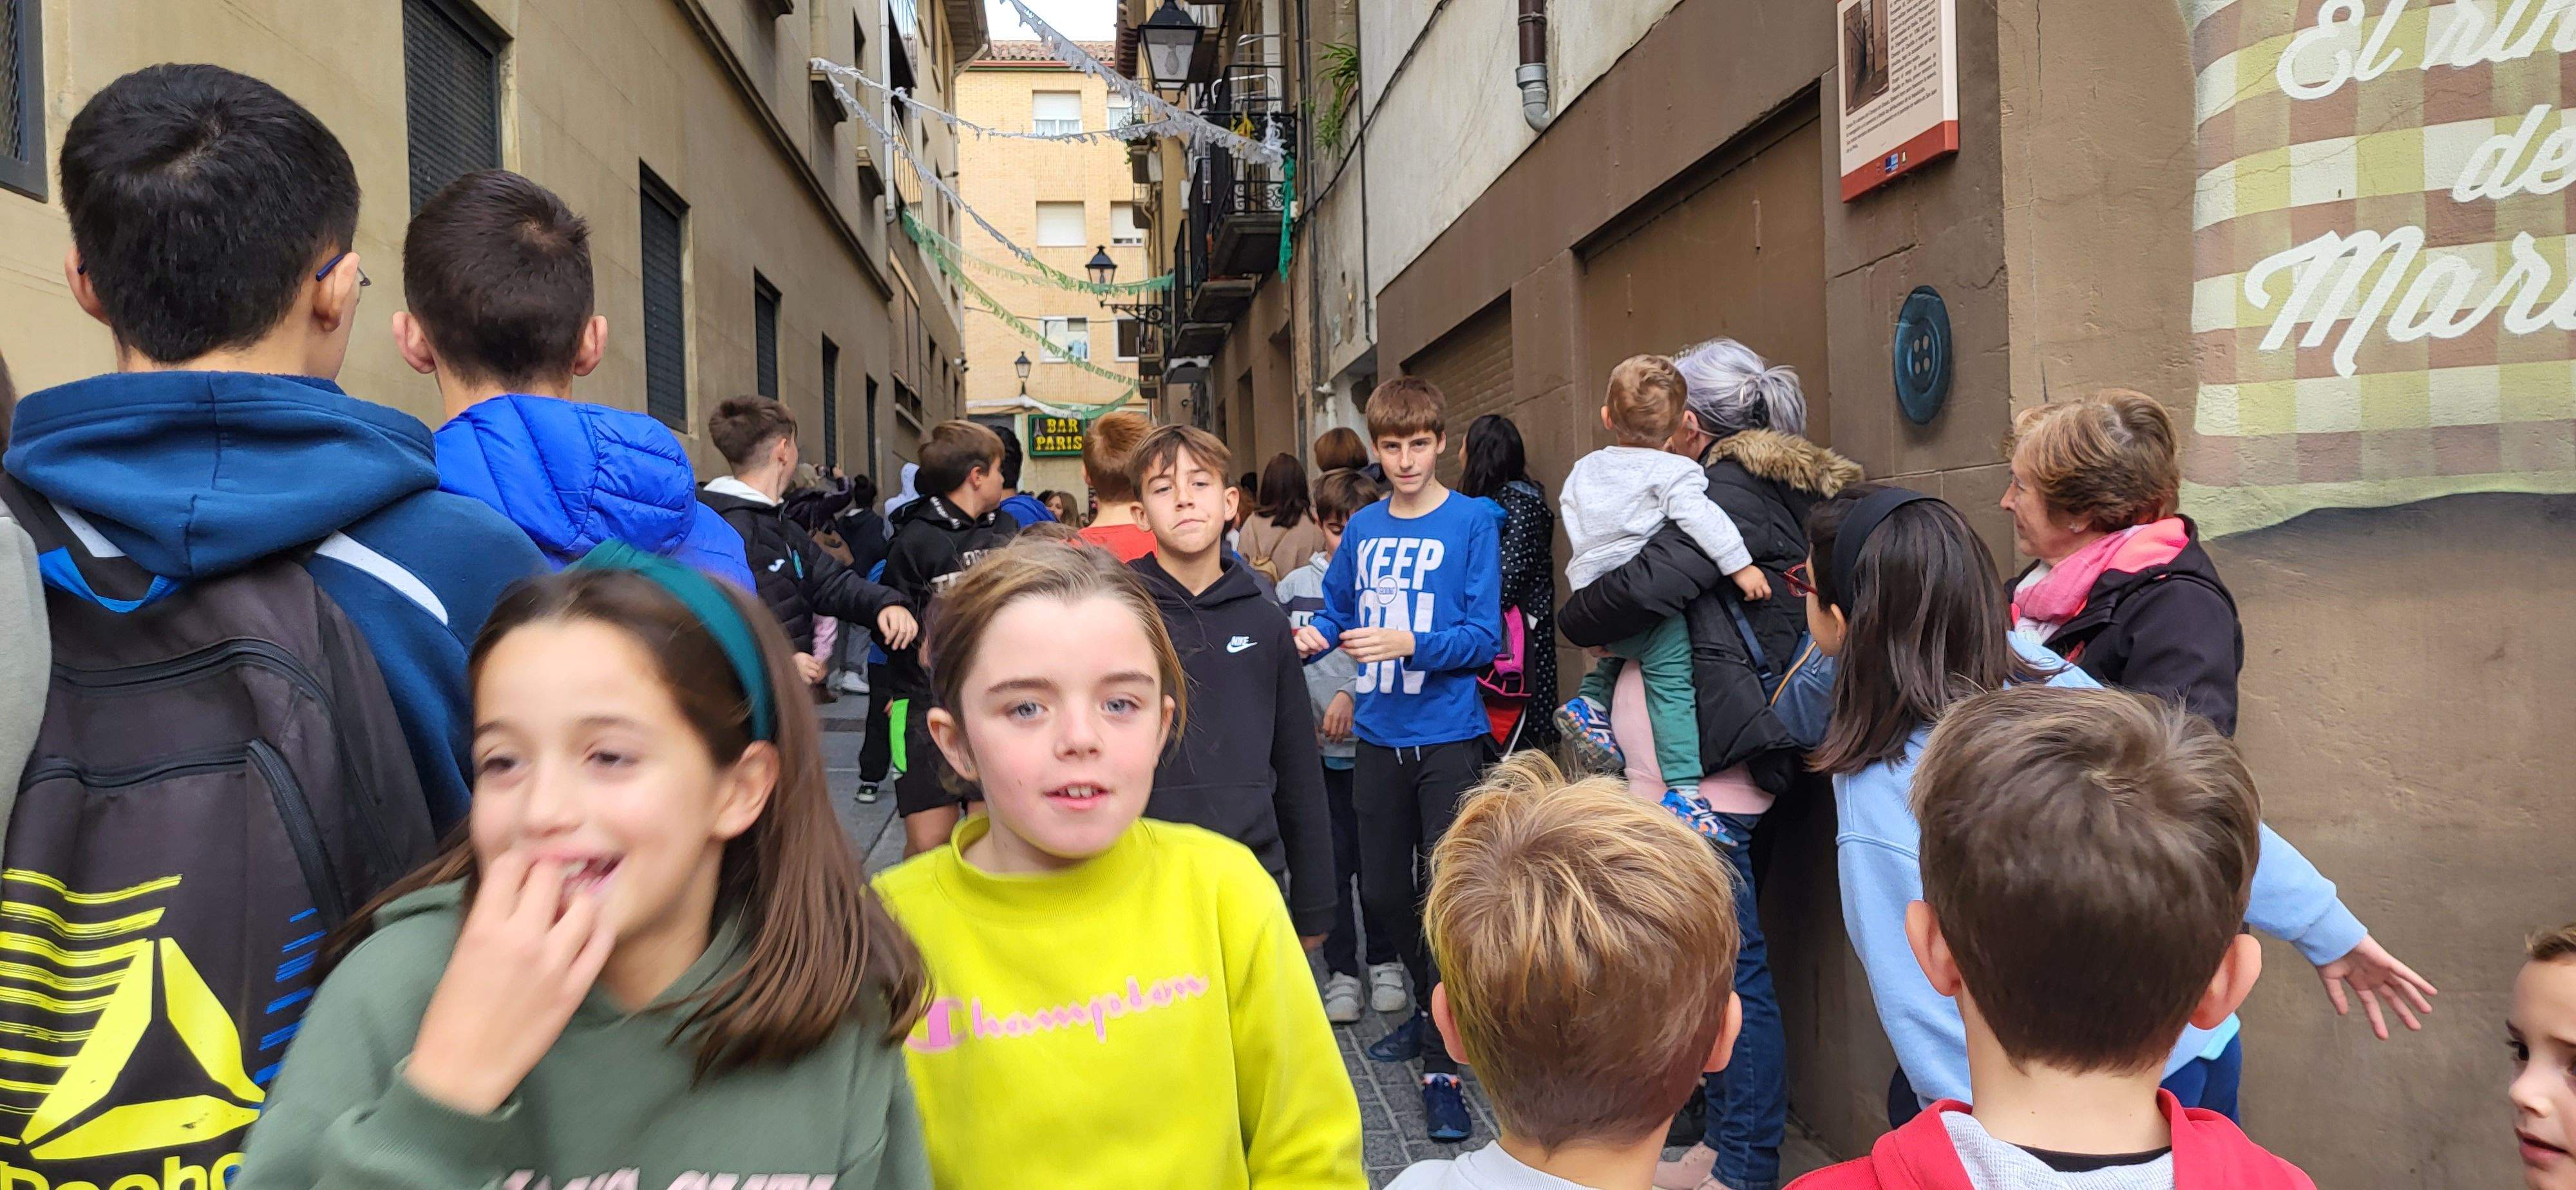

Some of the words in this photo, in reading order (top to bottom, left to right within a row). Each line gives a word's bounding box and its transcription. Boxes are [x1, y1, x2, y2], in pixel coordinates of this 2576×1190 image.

[2276, 0, 2404, 100] El
[2451, 104, 2576, 203] de
[1035, 435, 1083, 451] PARIS
[1046, 419, 1078, 433] BAR
[1355, 537, 1445, 590] KEEP
[1231, 636, 1250, 647] NIKE
